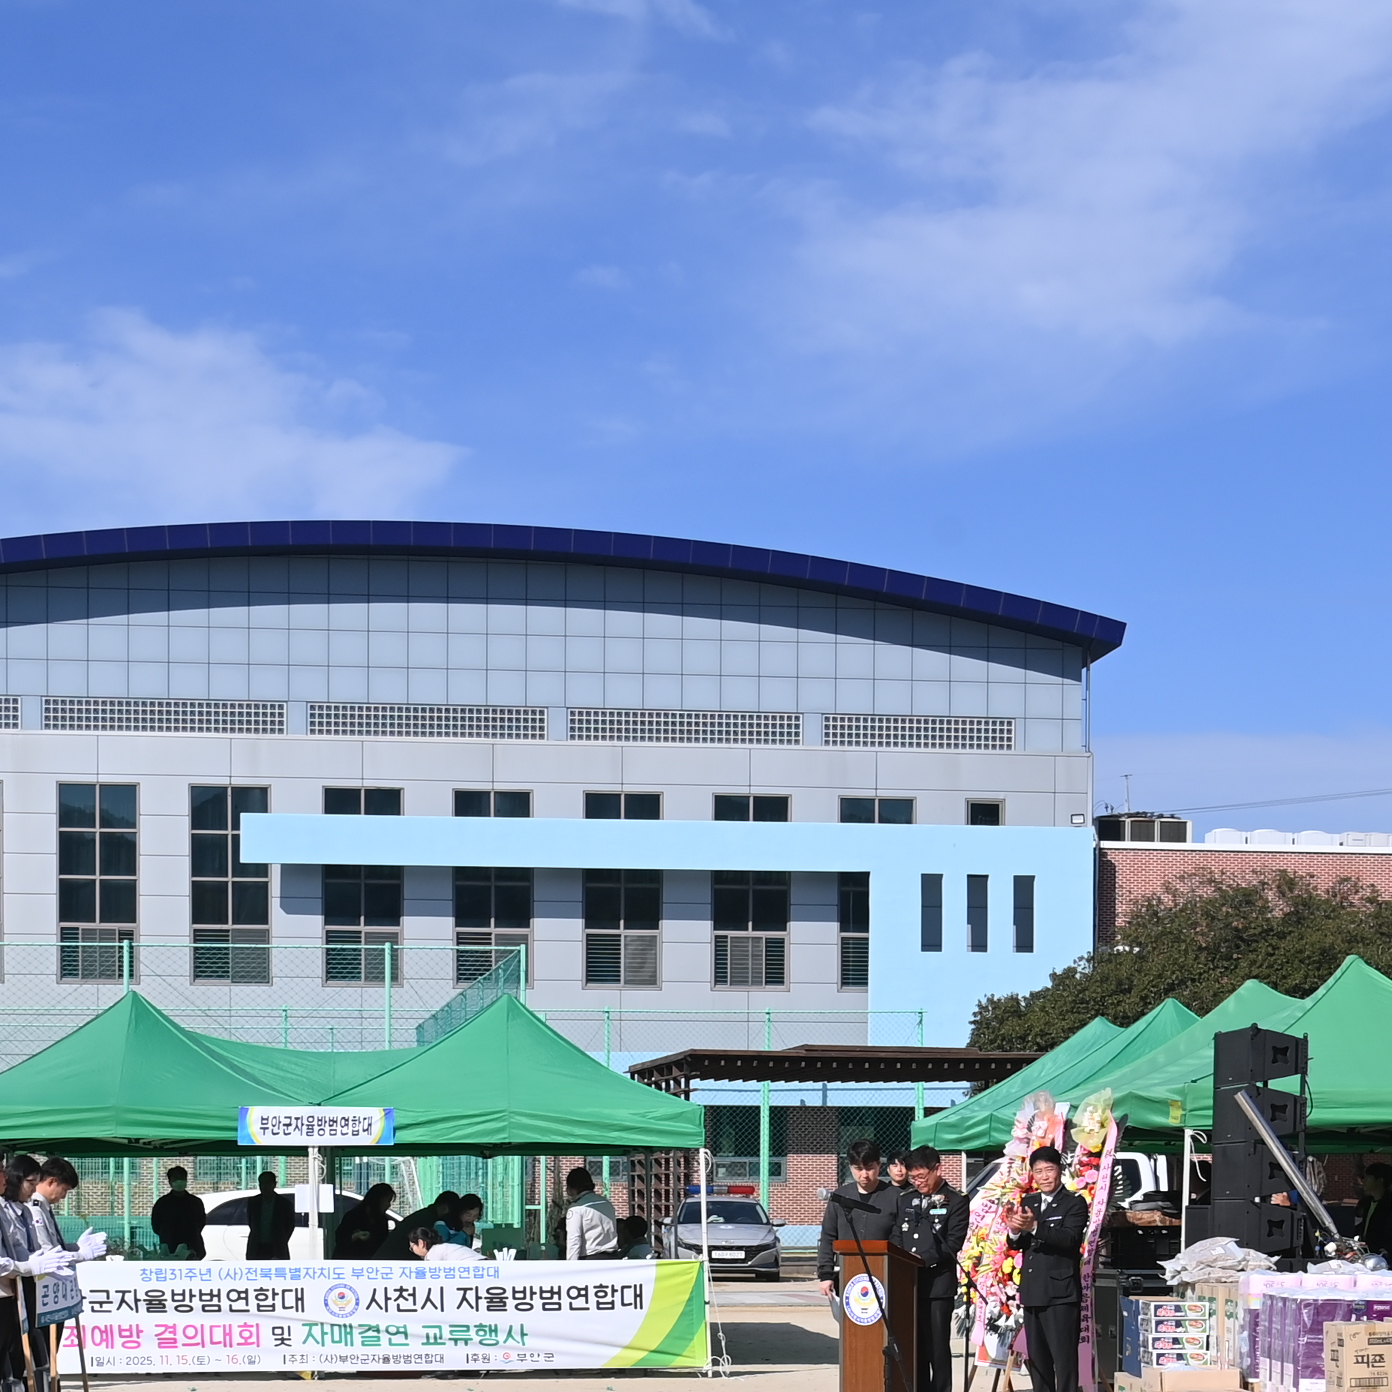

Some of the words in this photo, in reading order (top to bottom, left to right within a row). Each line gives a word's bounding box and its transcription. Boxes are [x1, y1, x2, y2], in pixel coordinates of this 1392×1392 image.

[259, 1115, 373, 1137] 부안군자율방범연합대
[139, 1267, 212, 1282] 창립31주년
[218, 1266, 346, 1282] (사)전북특별자치도
[351, 1266, 394, 1281] 부안군
[399, 1265, 500, 1280] 자율방범연합대
[81, 1287, 306, 1314] 군자율방범연합대
[365, 1285, 444, 1313] 사천시
[455, 1282, 644, 1312] 자율방범연합대
[154, 1322, 261, 1350] 결의대회
[271, 1325, 293, 1348] 및
[301, 1322, 410, 1348] 자매결연
[420, 1322, 529, 1347] 교류행사
[318, 1353, 445, 1365] (사)부안군자율방범연합대
[1353, 1353, 1386, 1369] 피죤
